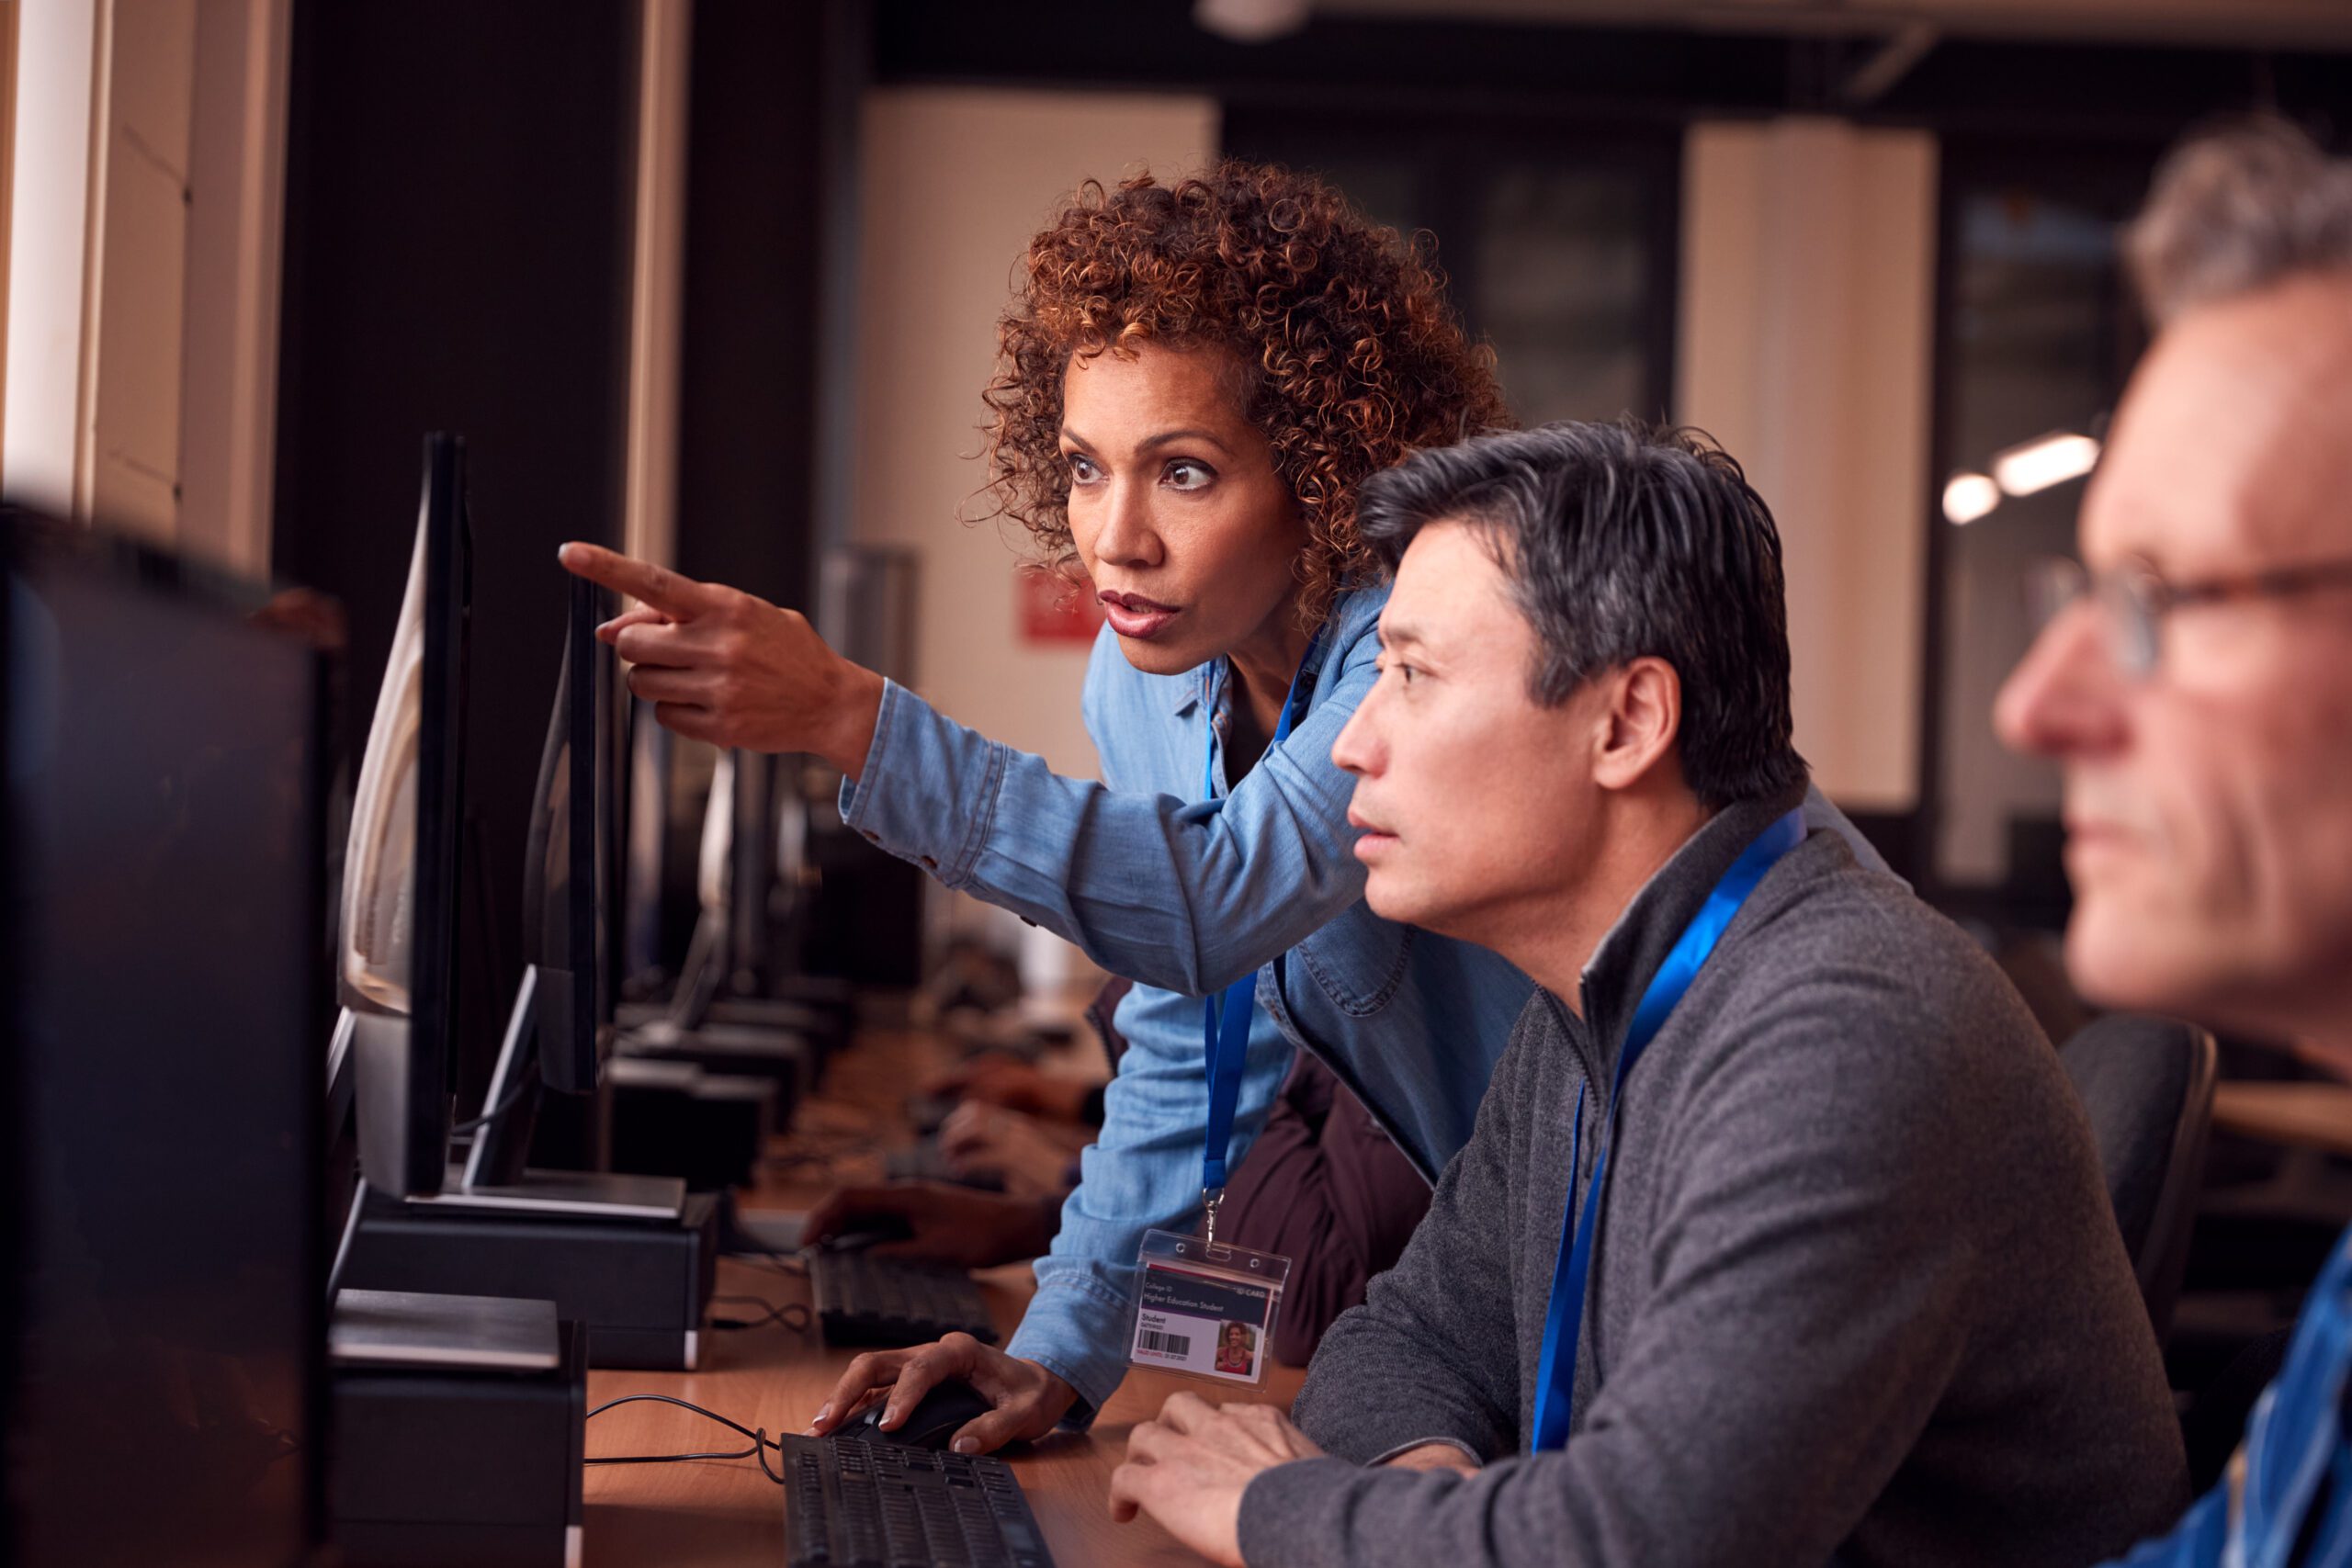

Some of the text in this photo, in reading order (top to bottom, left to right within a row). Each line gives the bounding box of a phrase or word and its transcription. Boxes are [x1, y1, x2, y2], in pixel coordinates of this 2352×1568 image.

[1146, 1282, 1165, 1292] College
[1245, 1289, 1266, 1298] CARD
[1144, 1293, 1224, 1312] Higher Education Student
[1141, 1314, 1166, 1324] Student
